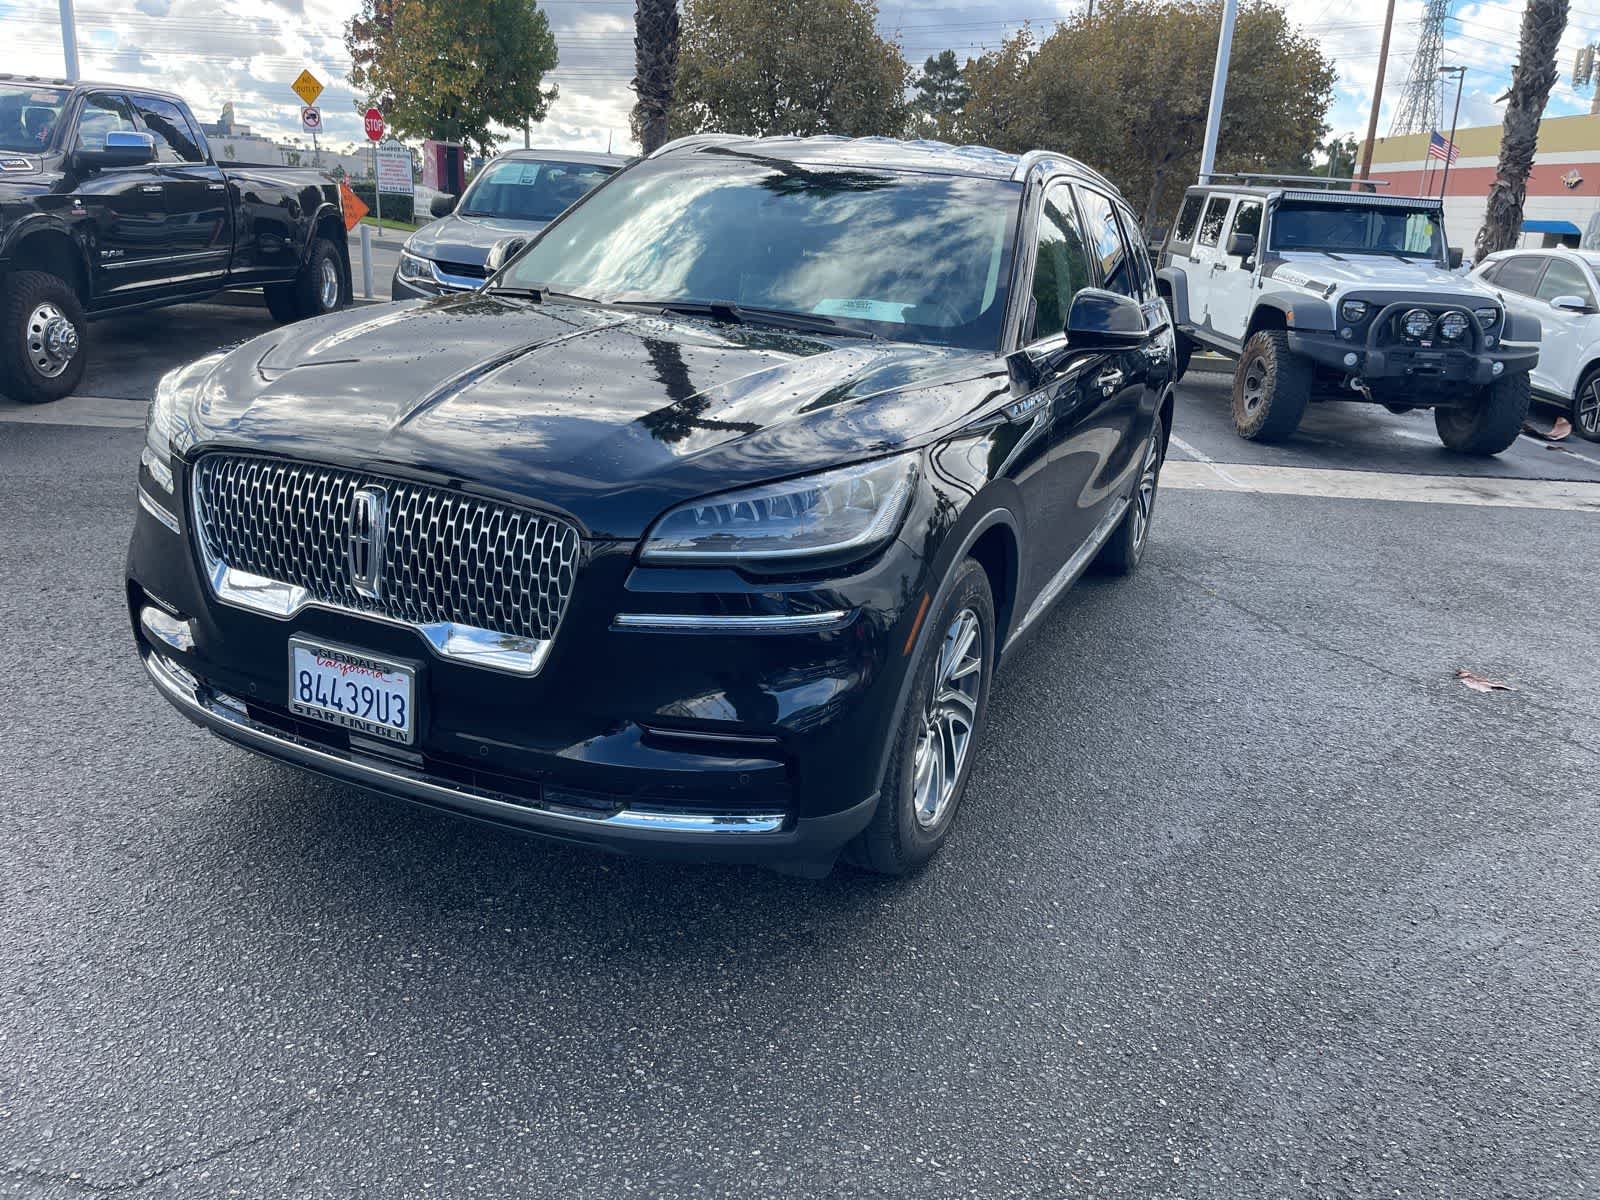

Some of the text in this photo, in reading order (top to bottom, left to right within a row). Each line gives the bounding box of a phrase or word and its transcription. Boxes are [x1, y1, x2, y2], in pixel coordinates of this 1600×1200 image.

[365, 118, 383, 132] STOP
[318, 648, 382, 672] GLENDALE
[299, 670, 406, 728] 84439U3
[293, 703, 335, 721] STAR
